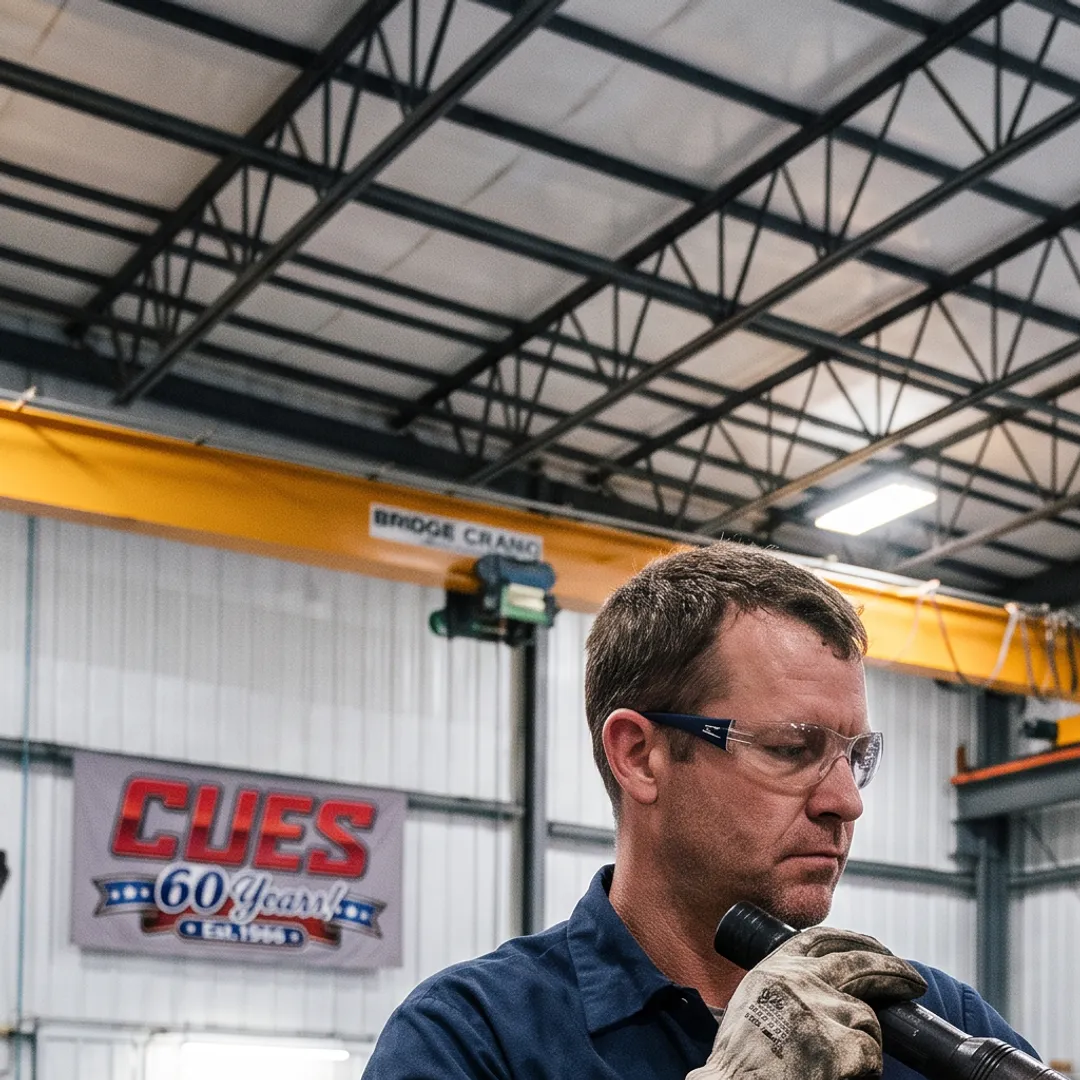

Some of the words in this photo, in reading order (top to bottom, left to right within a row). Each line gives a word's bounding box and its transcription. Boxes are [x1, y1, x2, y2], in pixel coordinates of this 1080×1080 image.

[374, 509, 455, 541] BRIDGE
[111, 777, 376, 879] CUES
[159, 866, 226, 910] 60
